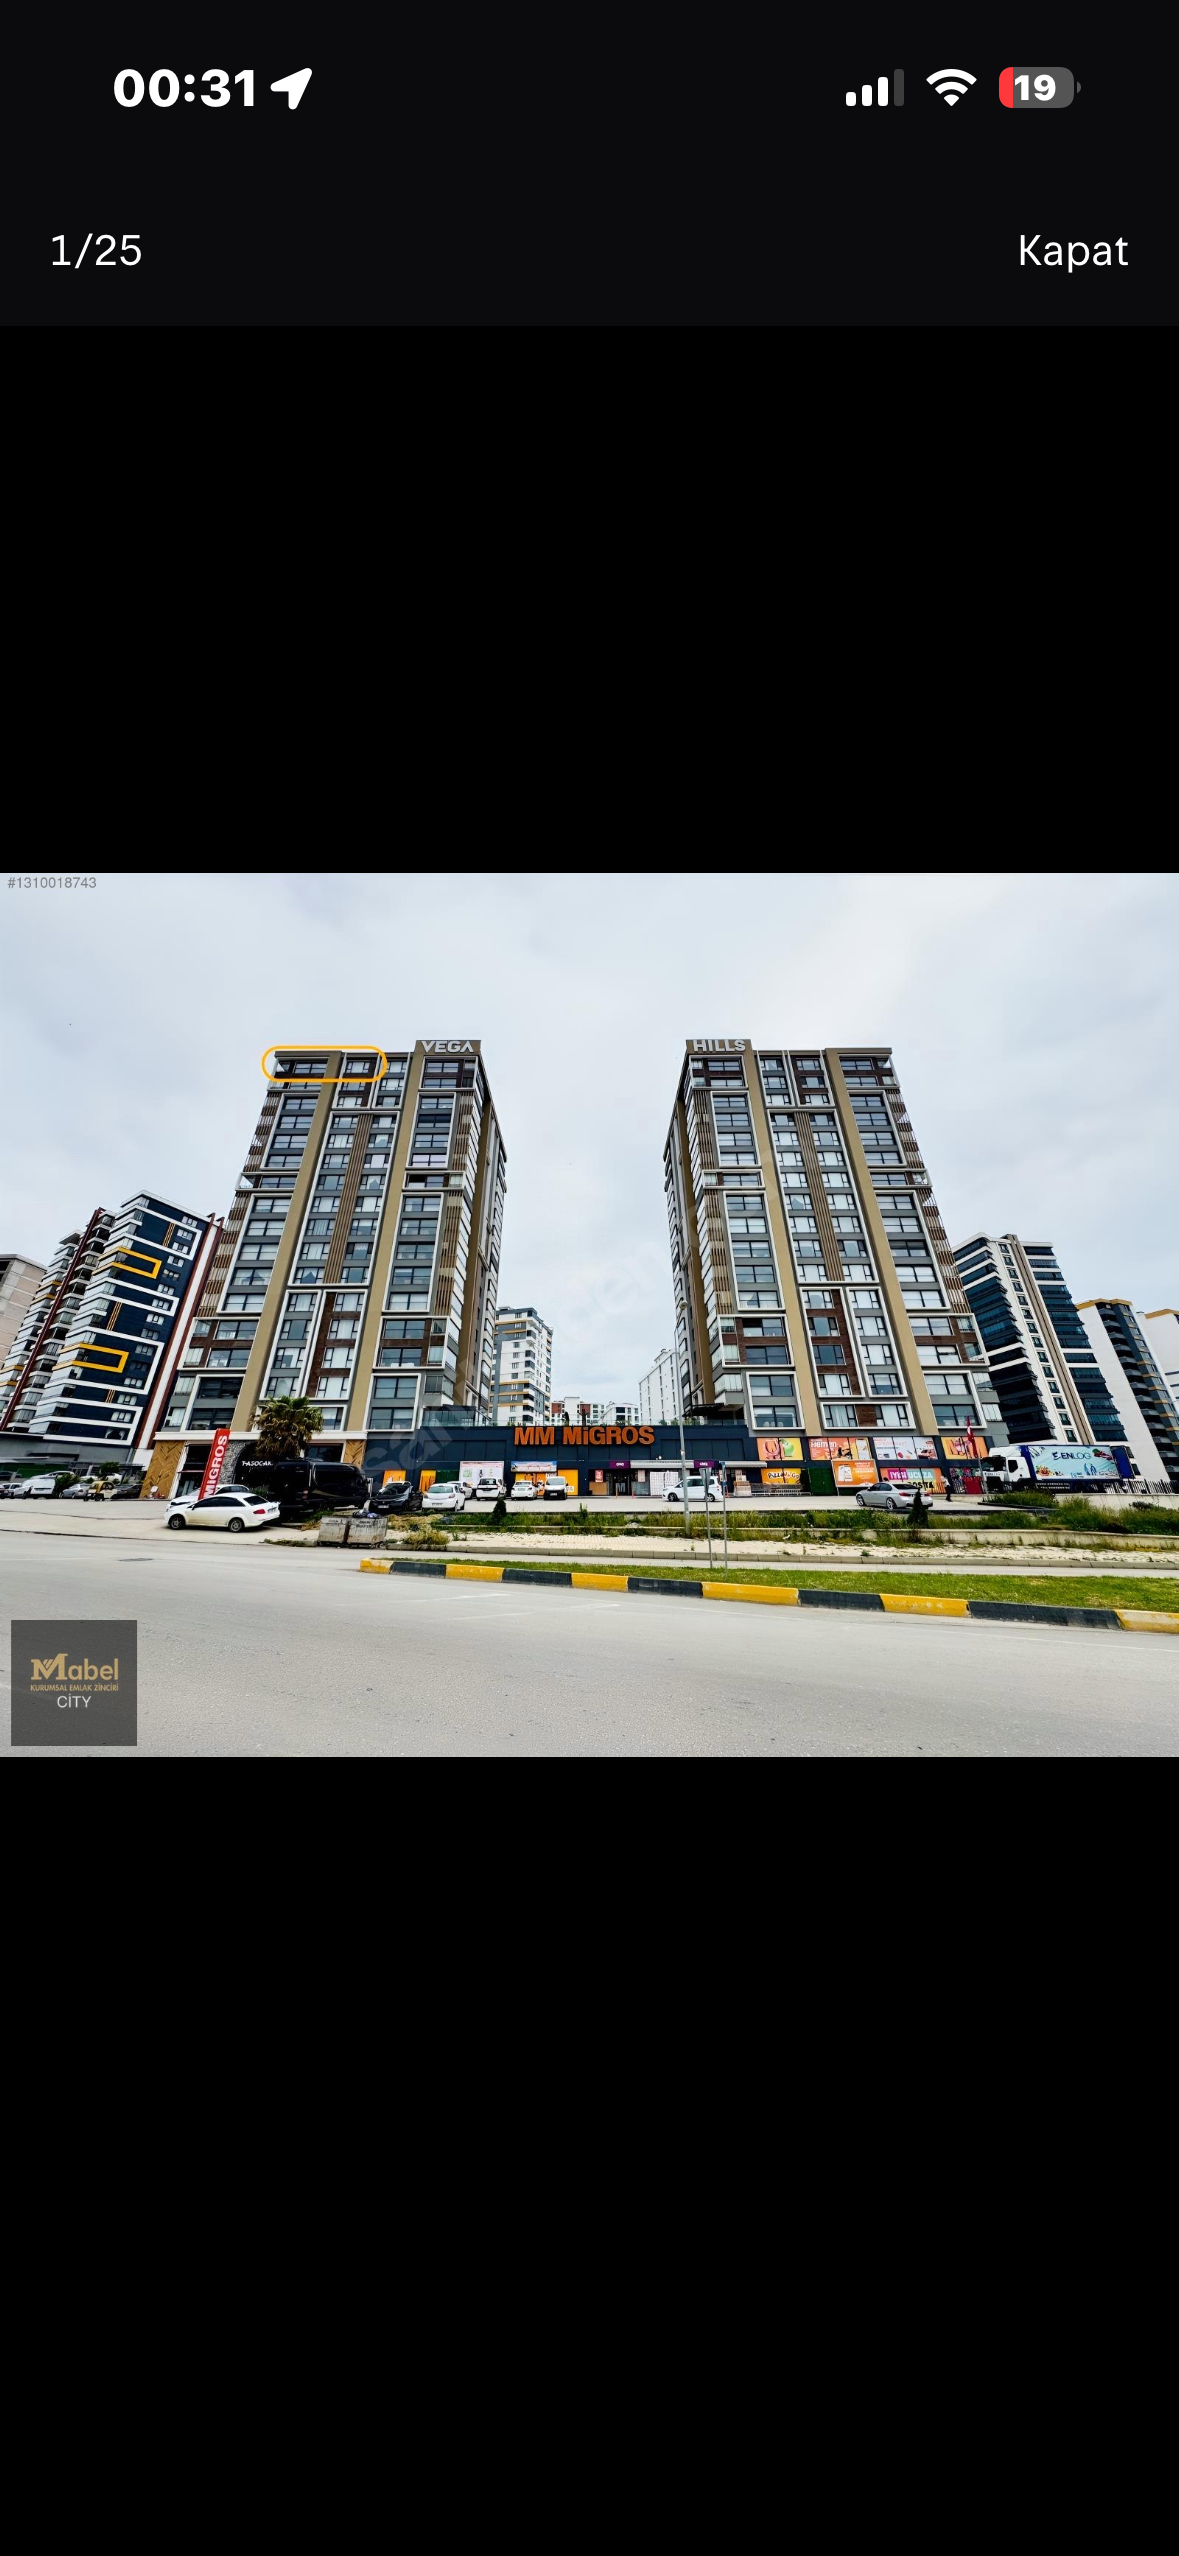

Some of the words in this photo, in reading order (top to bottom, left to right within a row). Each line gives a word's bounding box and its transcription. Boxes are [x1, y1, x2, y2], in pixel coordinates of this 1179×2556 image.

[421, 1039, 475, 1053] VEGA
[692, 1038, 746, 1052] HILLS
[514, 1426, 555, 1445] MM
